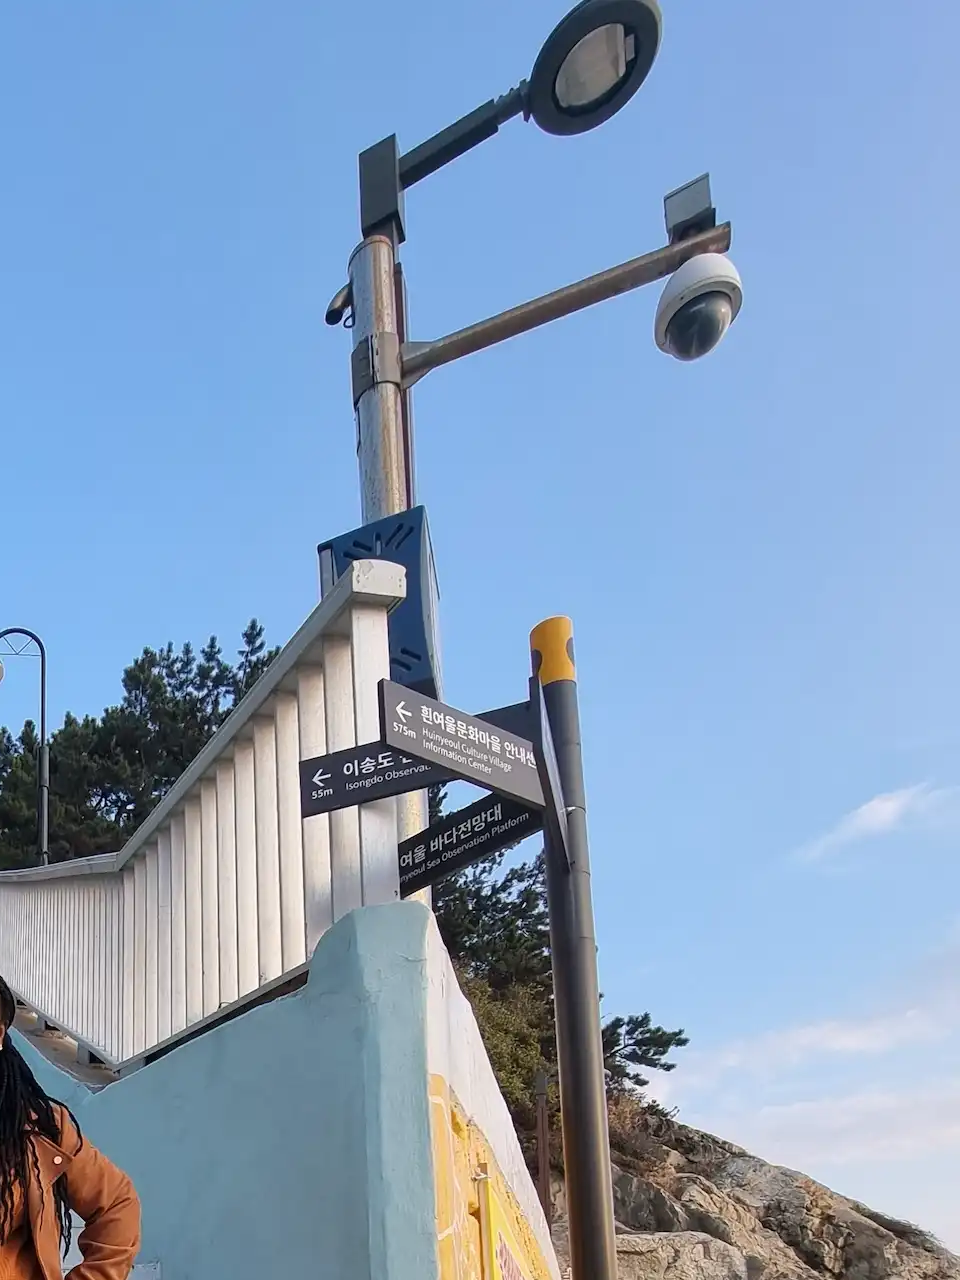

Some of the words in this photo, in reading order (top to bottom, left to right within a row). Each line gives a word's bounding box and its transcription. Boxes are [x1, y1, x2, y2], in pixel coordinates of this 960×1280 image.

[393, 722, 417, 739] 575m
[420, 704, 502, 754] 흰여울문화마을
[343, 751, 395, 776] 이송도
[422, 727, 461, 751] Huinyeoul
[461, 744, 488, 762] Culture
[490, 755, 512, 773] Village
[423, 740, 467, 765] Information
[468, 759, 492, 774] Center
[311, 788, 333, 800] 55m
[345, 776, 384, 791] Isongdo
[400, 844, 427, 867] 여울
[430, 803, 502, 852] 바다전망대
[426, 857, 441, 870] Sea
[441, 832, 490, 862] Observation
[491, 812, 529, 837] Platform
